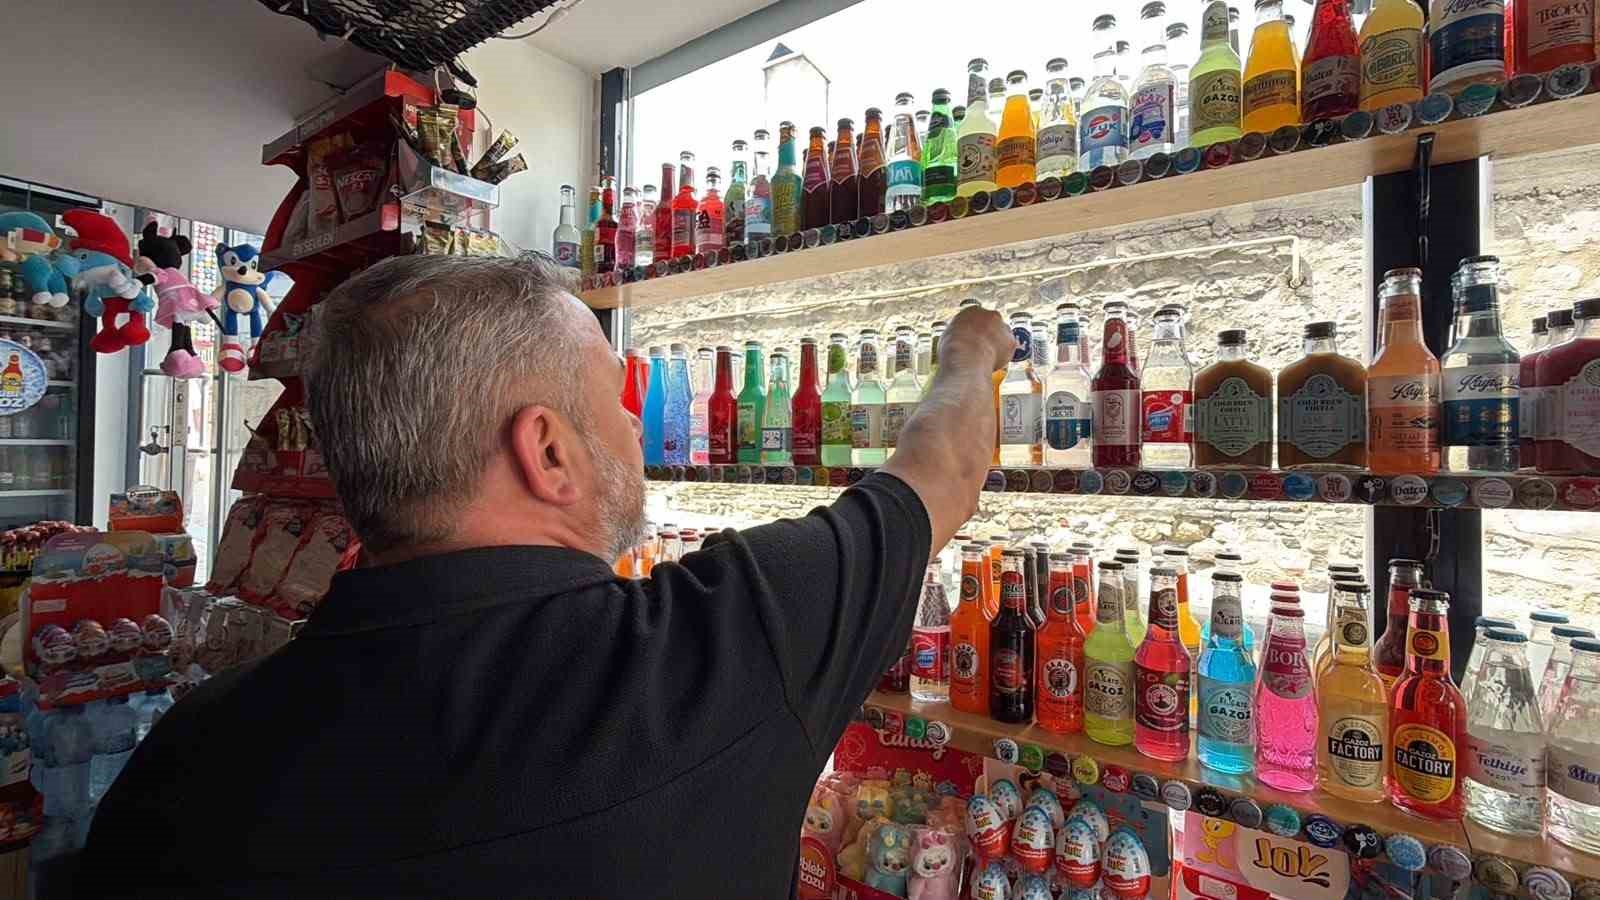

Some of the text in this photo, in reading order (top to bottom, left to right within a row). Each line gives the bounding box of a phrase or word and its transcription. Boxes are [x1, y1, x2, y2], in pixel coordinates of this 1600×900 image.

[1088, 680, 1123, 696] GAZOZ
[1209, 703, 1251, 721] GAZOZ
[1331, 741, 1381, 760] FACTORY
[1344, 737, 1370, 747] GAZOZ
[1397, 750, 1451, 776] FACTORY
[1477, 753, 1528, 776] Fethiye
[1254, 838, 1328, 877] JOY
